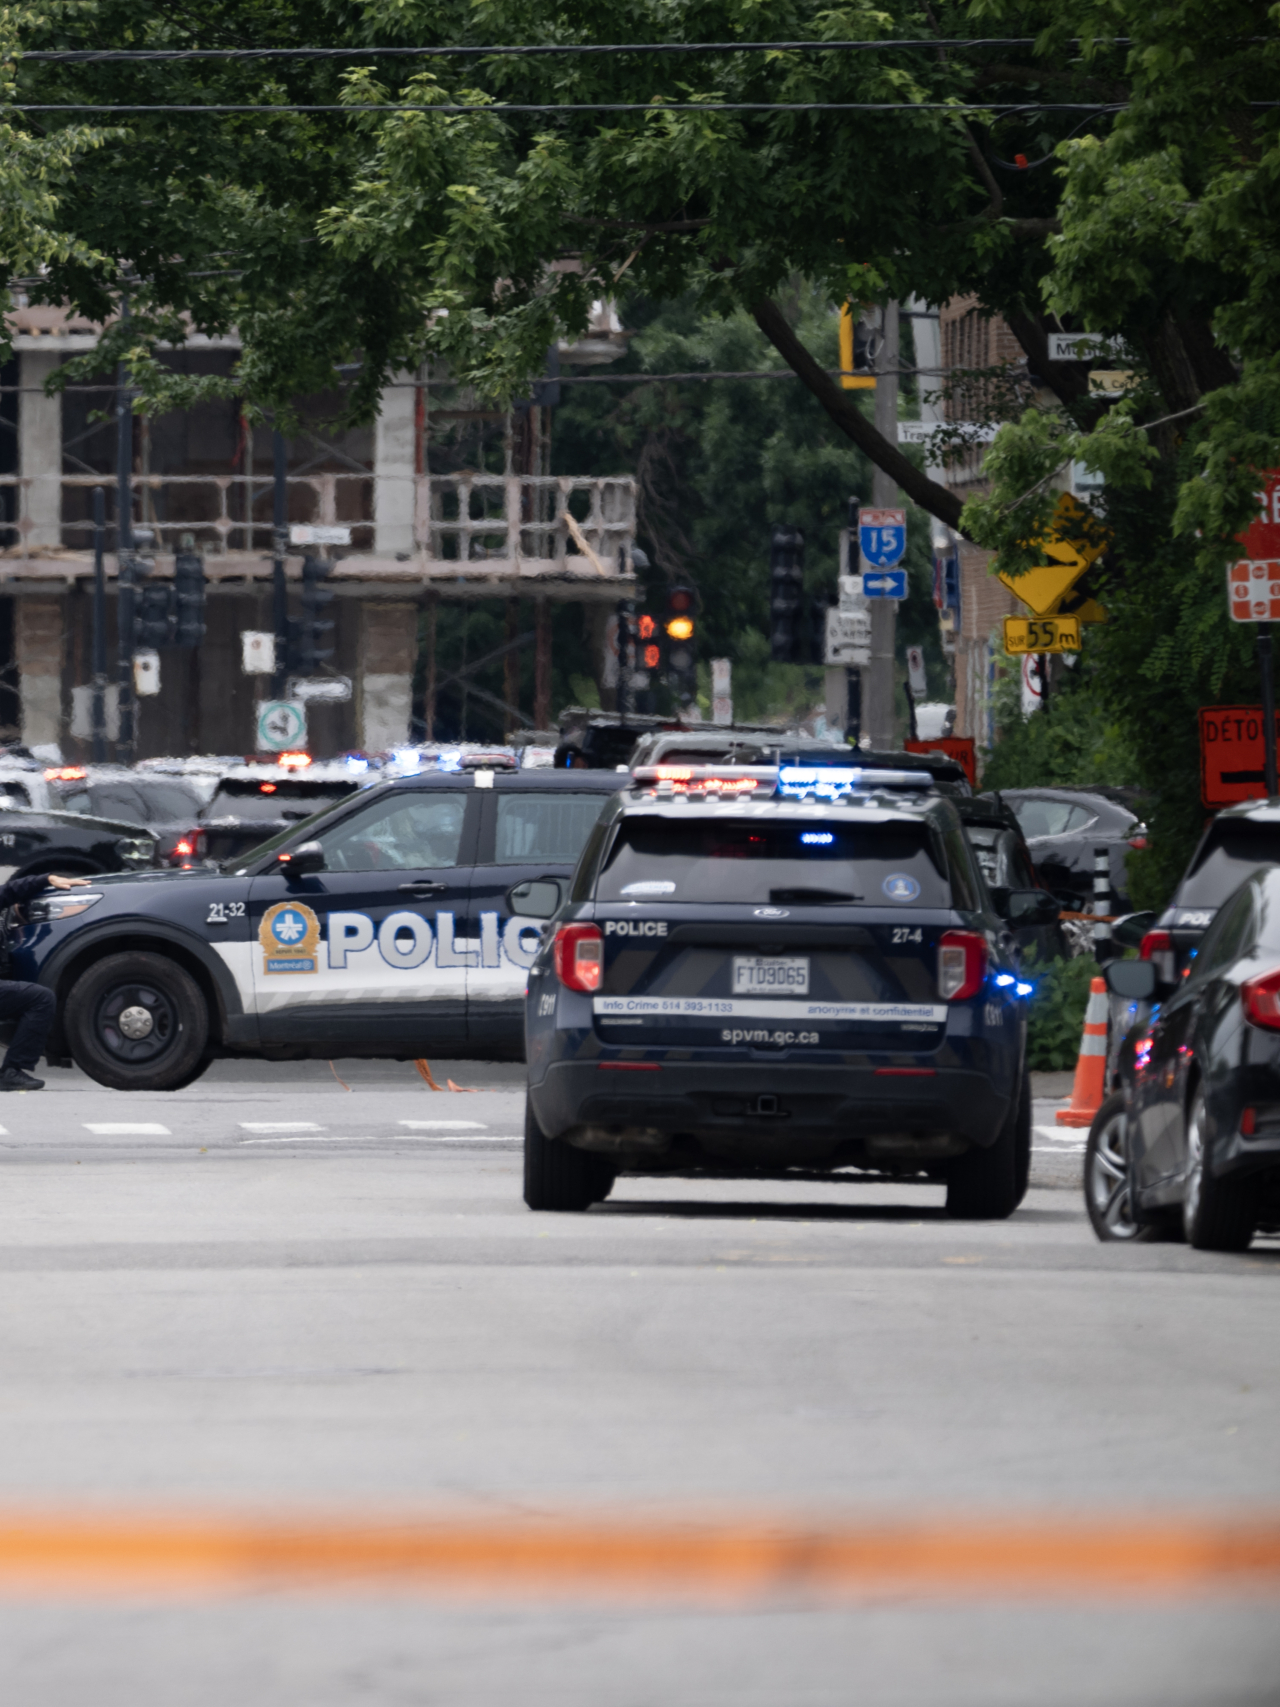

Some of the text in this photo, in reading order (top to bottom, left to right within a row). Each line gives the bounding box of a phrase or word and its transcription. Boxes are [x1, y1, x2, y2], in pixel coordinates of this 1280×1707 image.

[871, 529, 897, 553] 15
[1028, 622, 1054, 648] 55
[1059, 633, 1076, 646] m
[1206, 715, 1280, 742] DÉTO
[209, 902, 245, 917] 21-32
[1179, 912, 1213, 925] POL
[605, 921, 668, 937] POLICE
[892, 927, 923, 944] 27-4
[327, 909, 544, 970] POLIC
[603, 1001, 733, 1013] Info Crime 514 393-1133
[807, 1005, 857, 1017] anonyme
[873, 1006, 934, 1017] confidentiel
[722, 1029, 820, 1046] spvm.qc.ca
